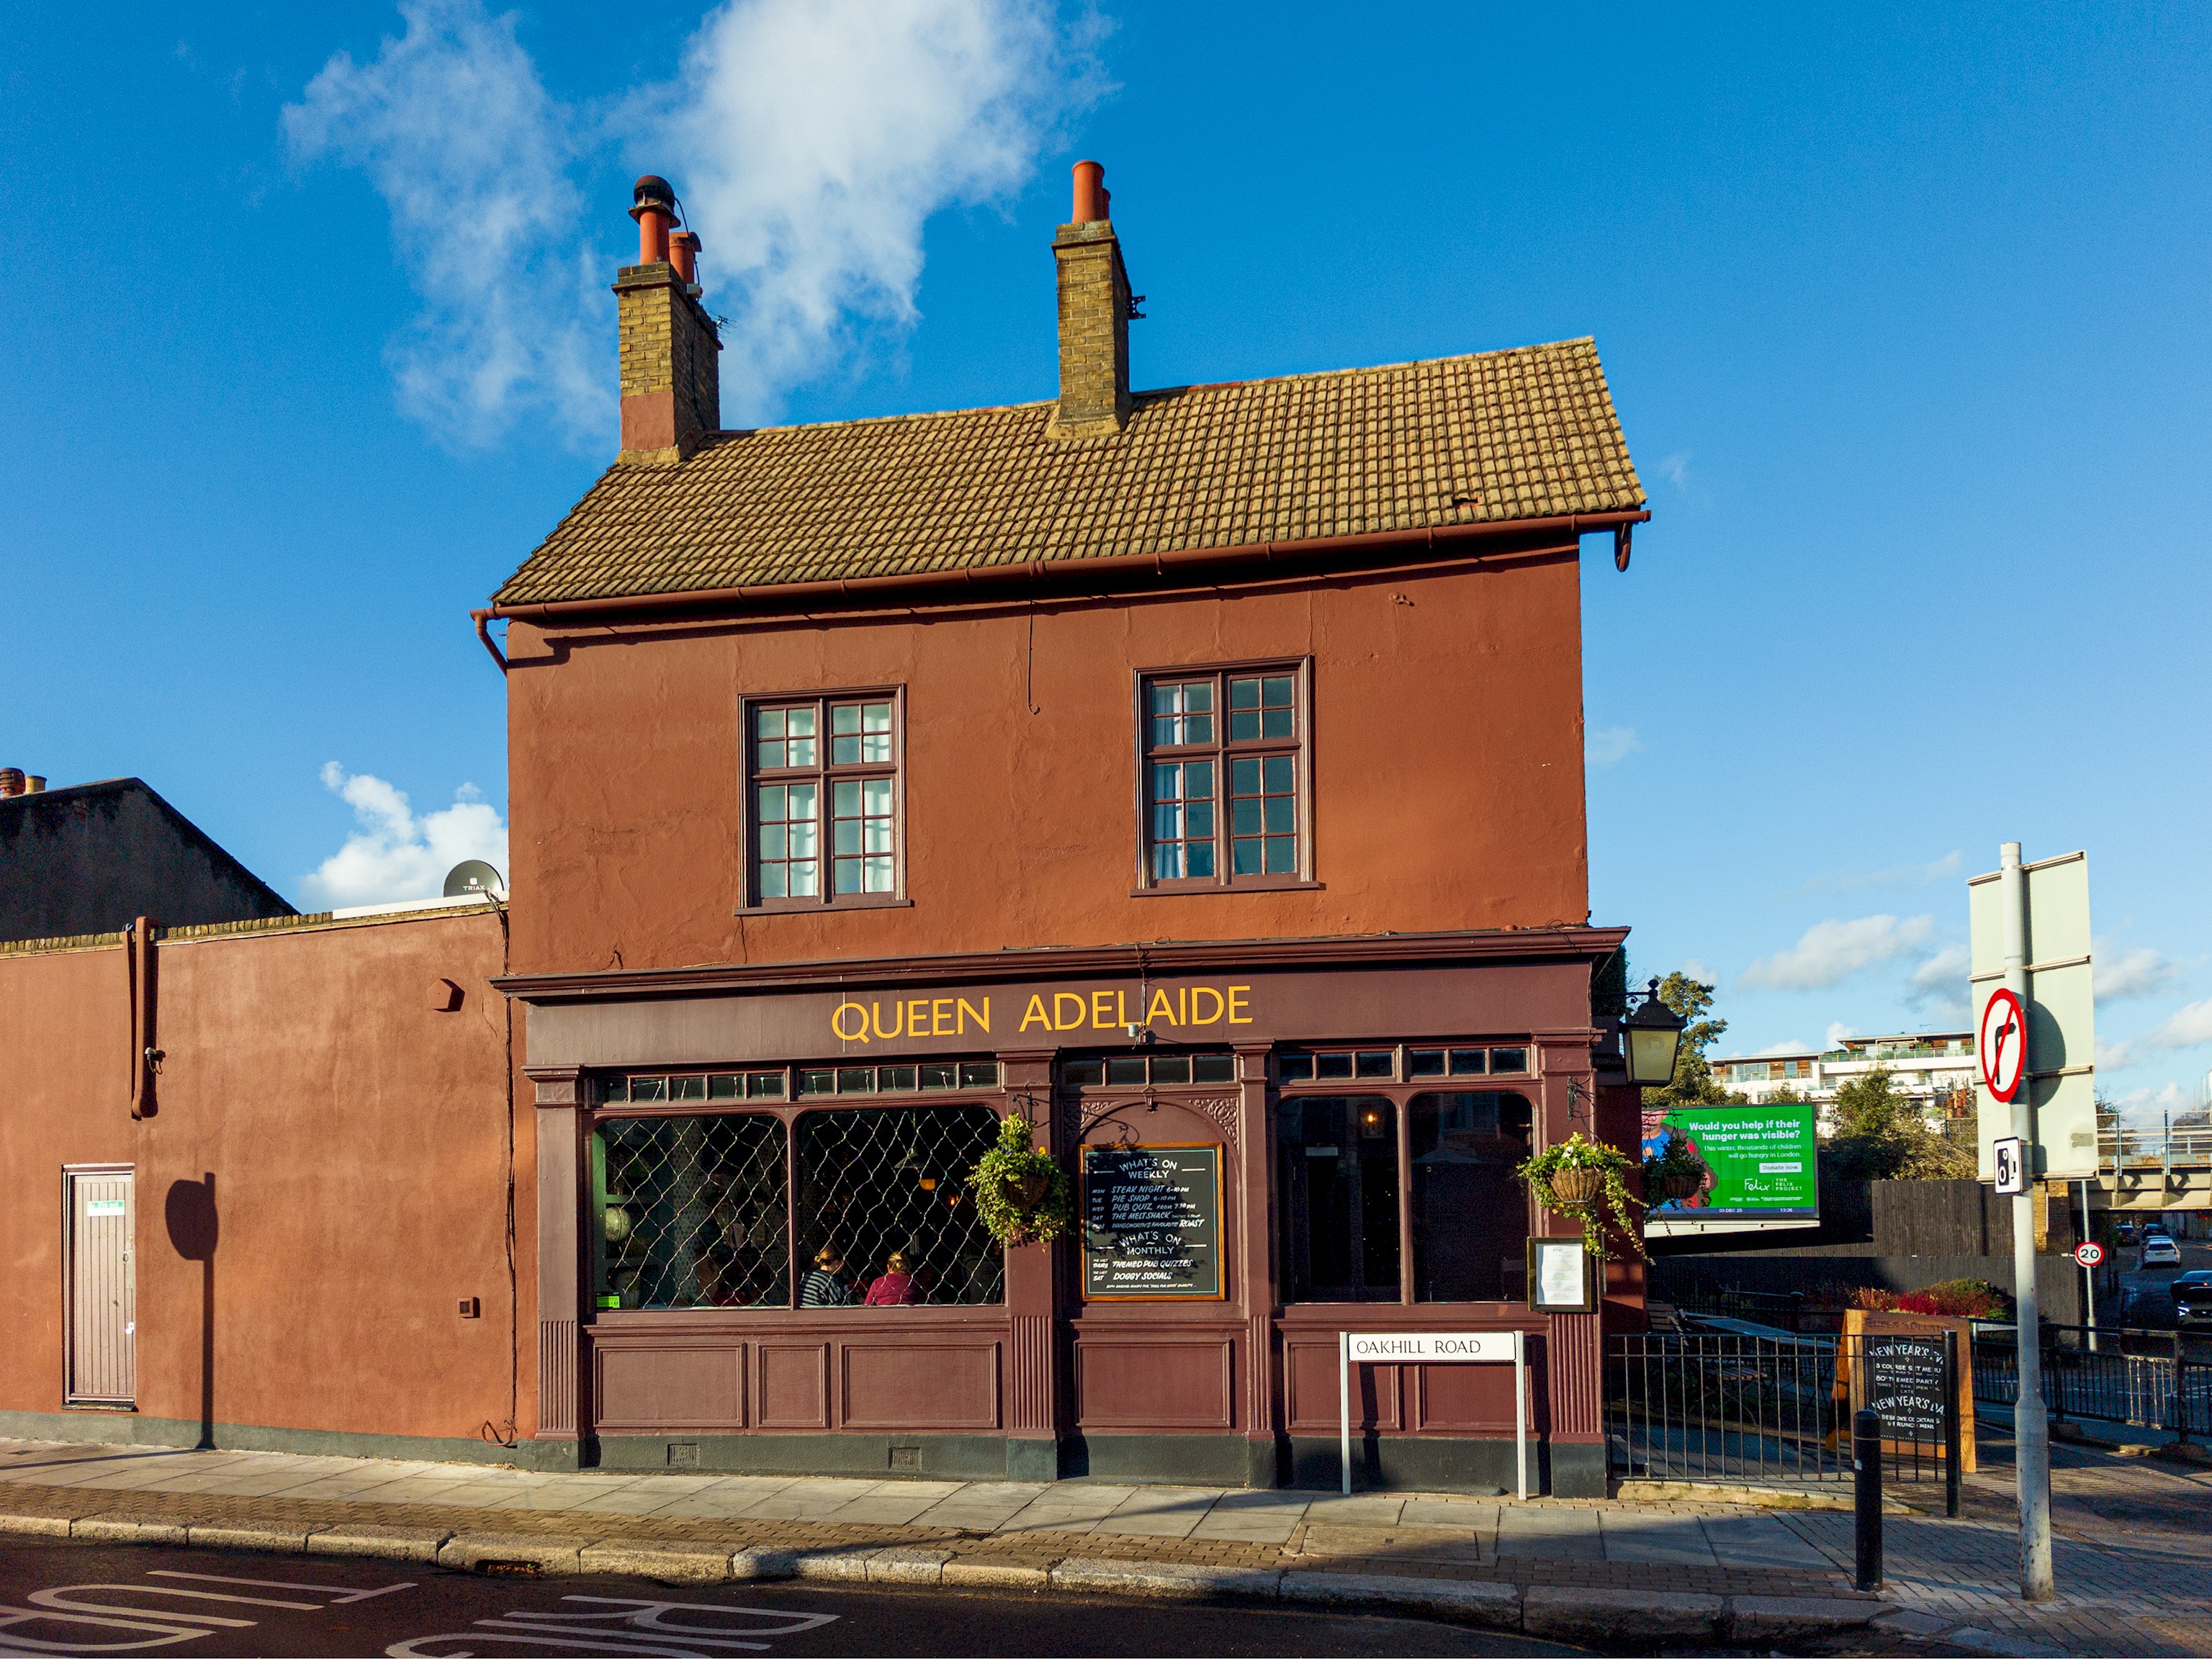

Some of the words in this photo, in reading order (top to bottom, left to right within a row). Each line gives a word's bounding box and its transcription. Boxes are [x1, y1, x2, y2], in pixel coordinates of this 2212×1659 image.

[832, 997, 990, 1043] QUEEN
[1019, 986, 1253, 1033] ADELAIDE
[1689, 1122, 1719, 1130] Would
[1722, 1123, 1740, 1131] you
[1742, 1120, 1763, 1130] help
[1766, 1120, 1773, 1128] if
[1776, 1120, 1800, 1128] their
[1702, 1132, 1737, 1142] hunger
[1761, 1130, 1800, 1139] visible?
[1119, 1158, 1158, 1172] WHAT'S
[1161, 1159, 1178, 1170] ON
[1128, 1170, 1169, 1179] WEEKLY
[1745, 1178, 1770, 1191] Felix
[1131, 1202, 1153, 1212] QUIZ
[1179, 1218, 1205, 1227] ROAST
[1118, 1231, 1159, 1247] WHAT'S
[1165, 1233, 1181, 1246] ON
[1127, 1246, 1174, 1255] MONTHLY
[2081, 1249, 2099, 1259] 20
[1159, 1259, 1193, 1268] QUIZZES
[1112, 1272, 1142, 1280] DOGGY
[1141, 1271, 1173, 1280] SOCIALS
[1357, 1340, 1426, 1354] OAKHILL
[1435, 1339, 1481, 1354] ROAD
[1896, 1395, 1930, 1410] YEAR'S
